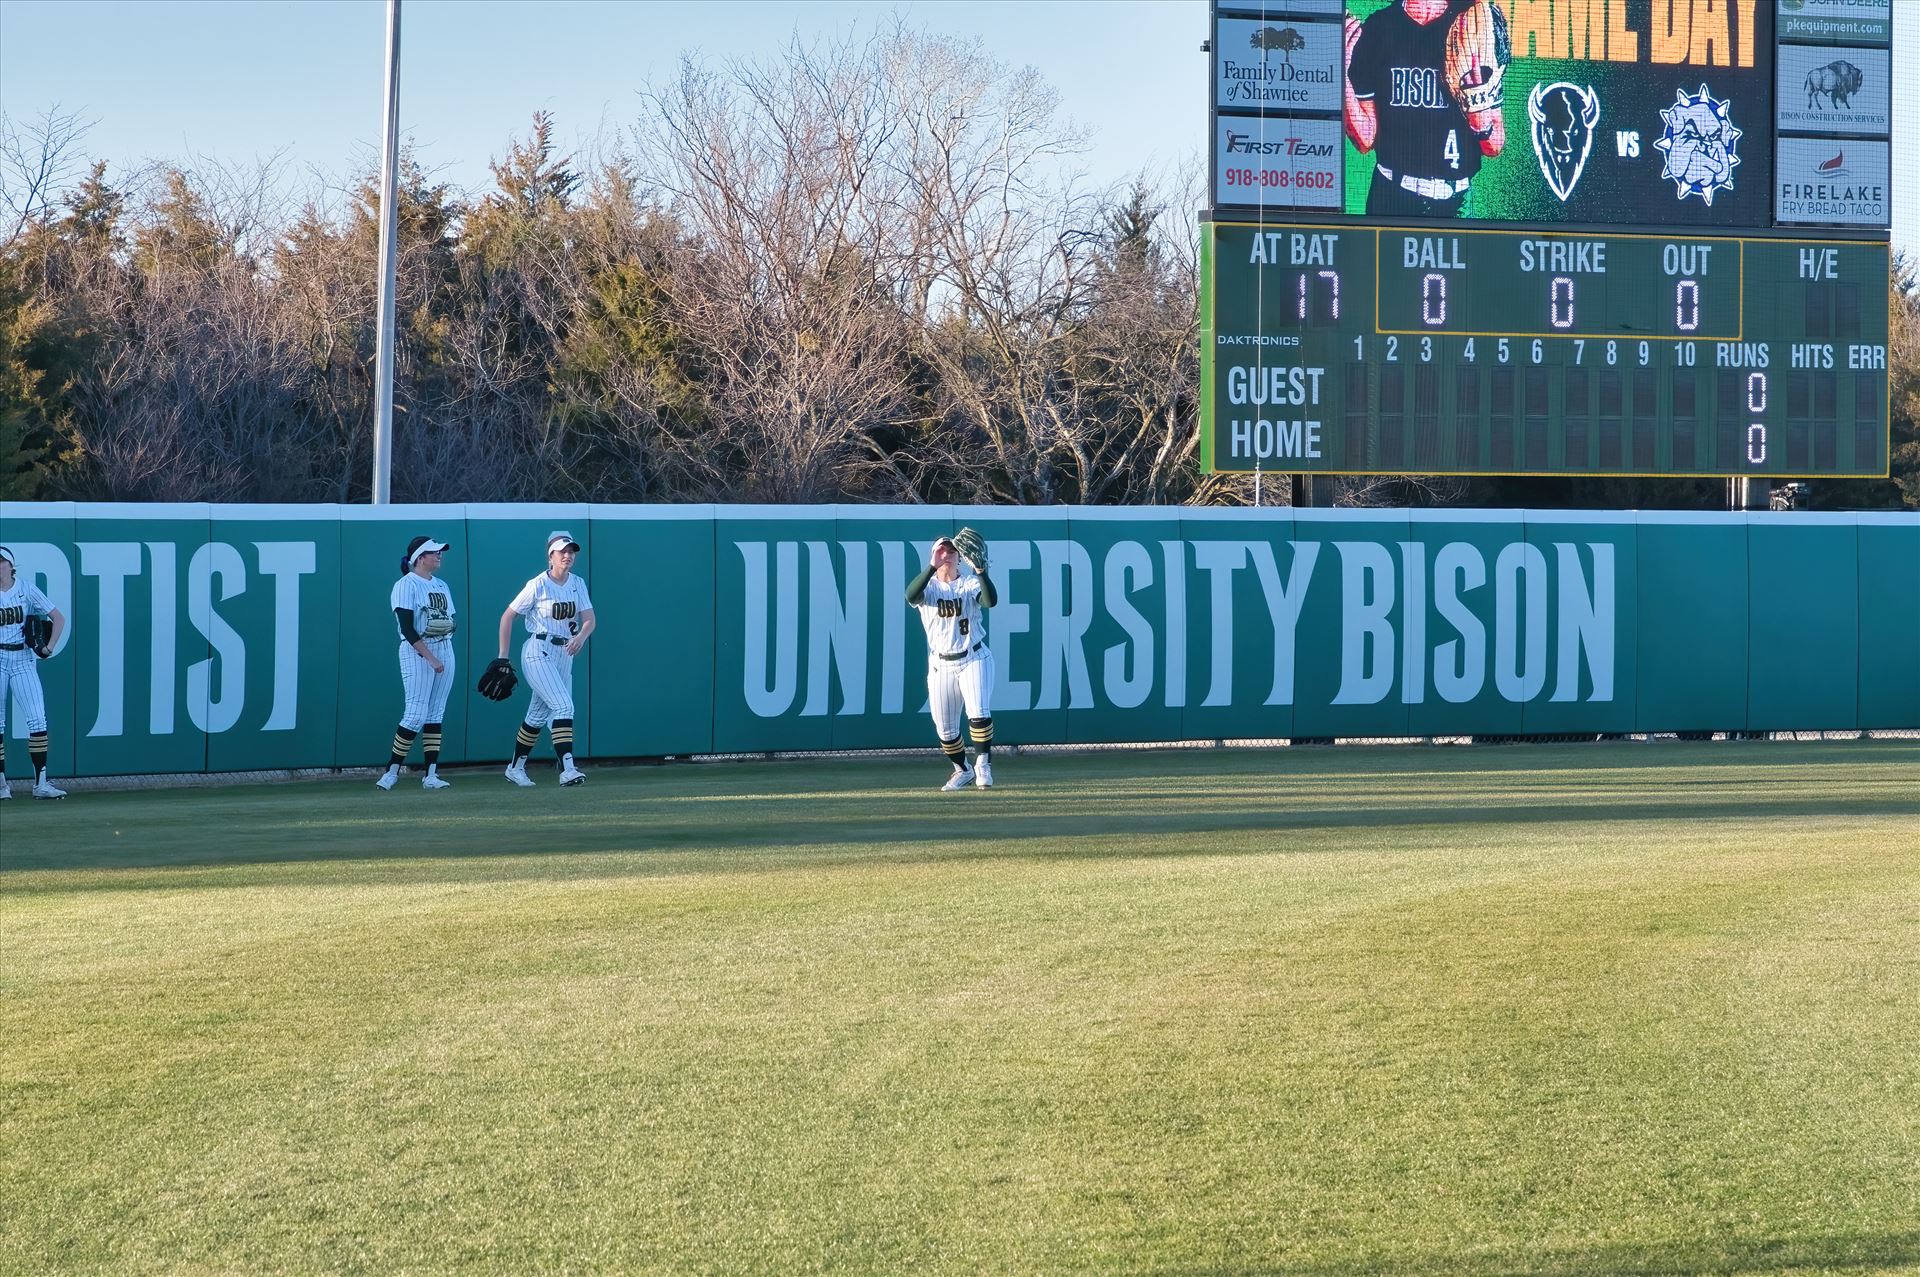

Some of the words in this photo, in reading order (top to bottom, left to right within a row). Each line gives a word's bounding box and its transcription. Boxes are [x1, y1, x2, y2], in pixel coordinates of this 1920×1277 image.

[1786, 19, 1882, 34] pkequipment.com
[1224, 60, 1277, 85] Family
[1280, 62, 1334, 83] Dental
[1226, 81, 1243, 101] of
[1242, 81, 1308, 101] Shawnee
[1781, 112, 1801, 120] BISON
[1802, 112, 1854, 122] CONSTRUCTION
[1854, 114, 1885, 123] SERVICES
[1444, 129, 1460, 169] 4
[1616, 131, 1640, 158] VS
[1226, 168, 1334, 189] 918-808-6602
[1782, 184, 1882, 201] FIRELAKE
[1782, 201, 1804, 214] FRY
[1808, 202, 1846, 215] BREAD
[1850, 203, 1882, 216] TACO
[1250, 232, 1282, 264] AT
[1290, 233, 1338, 266] BAT
[1403, 237, 1466, 269] BALL
[1520, 240, 1606, 273] STRIKE
[1663, 243, 1712, 276] OUT
[1799, 248, 1838, 281] H/E
[1298, 270, 1340, 319] 17
[1423, 273, 1447, 325] 0
[1551, 277, 1574, 328] 0
[1676, 280, 1699, 330] 0
[1217, 335, 1300, 347] DAKTRONICS
[1354, 335, 1363, 360] 1
[1386, 336, 1398, 361] 2
[1421, 336, 1432, 362] 3
[1464, 337, 1475, 362] 4
[1498, 338, 1509, 363] 5
[1532, 339, 1543, 364] 6
[1574, 339, 1584, 365] 7
[1606, 340, 1617, 365] 8
[1639, 341, 1649, 366] 9
[1674, 341, 1696, 367] 10
[1716, 342, 1769, 368] RUNS
[1791, 344, 1834, 369] HITS
[1849, 345, 1886, 370] ERR
[1228, 366, 1324, 405] GUEST
[1748, 372, 1766, 412] 0
[1231, 420, 1321, 458] HOME
[1748, 424, 1766, 463] 0
[552, 601, 576, 620] OBU
[937, 597, 962, 617] OBU
[568, 621, 580, 636] 2
[733, 540, 1321, 717] UNIERSITY
[1330, 541, 1615, 704] BISON
[958, 618, 969, 636] 8
